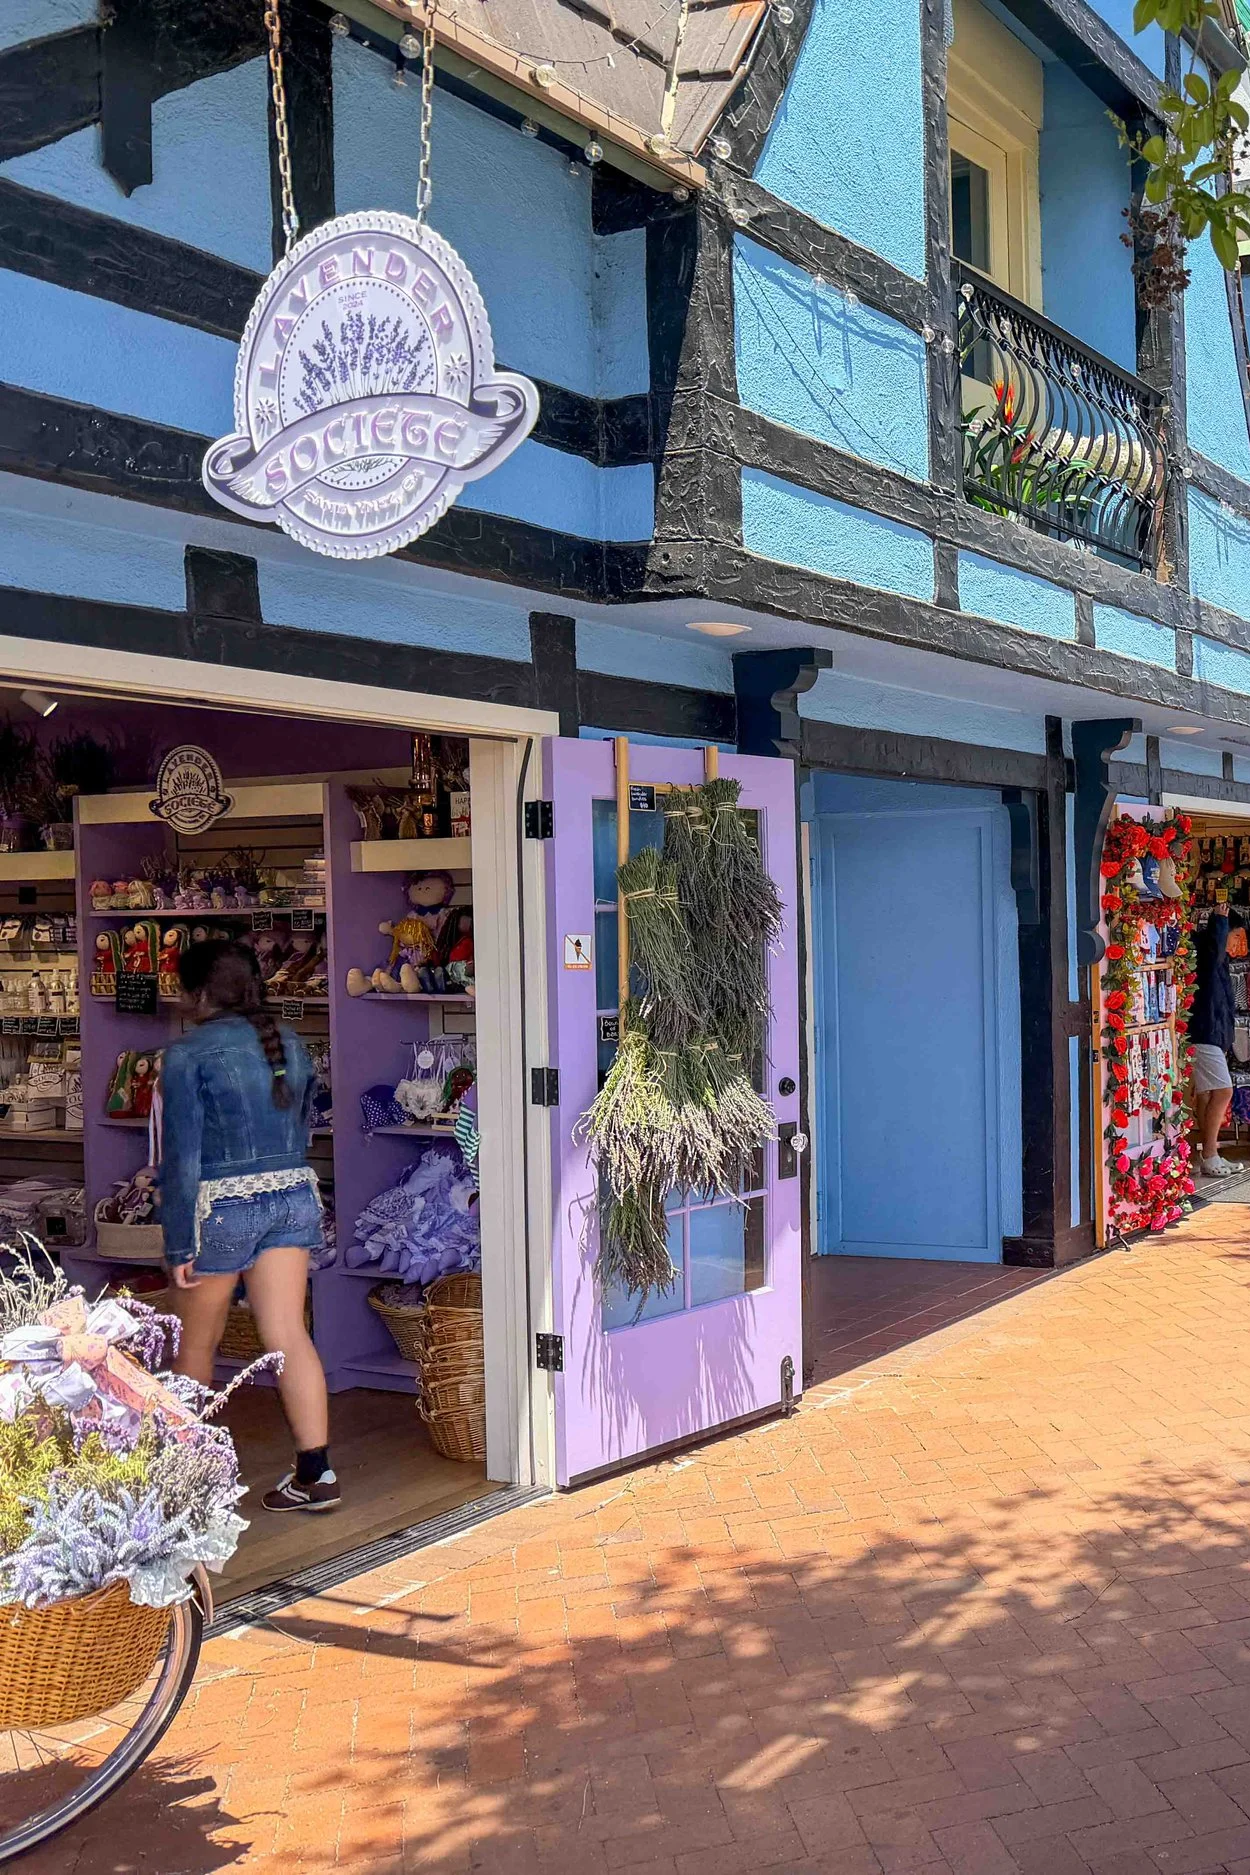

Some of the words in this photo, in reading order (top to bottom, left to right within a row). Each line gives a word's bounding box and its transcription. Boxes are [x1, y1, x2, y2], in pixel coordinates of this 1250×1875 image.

[257, 247, 455, 376] LAVENDER
[338, 291, 367, 304] SINCE
[163, 753, 214, 787] LAVENDER
